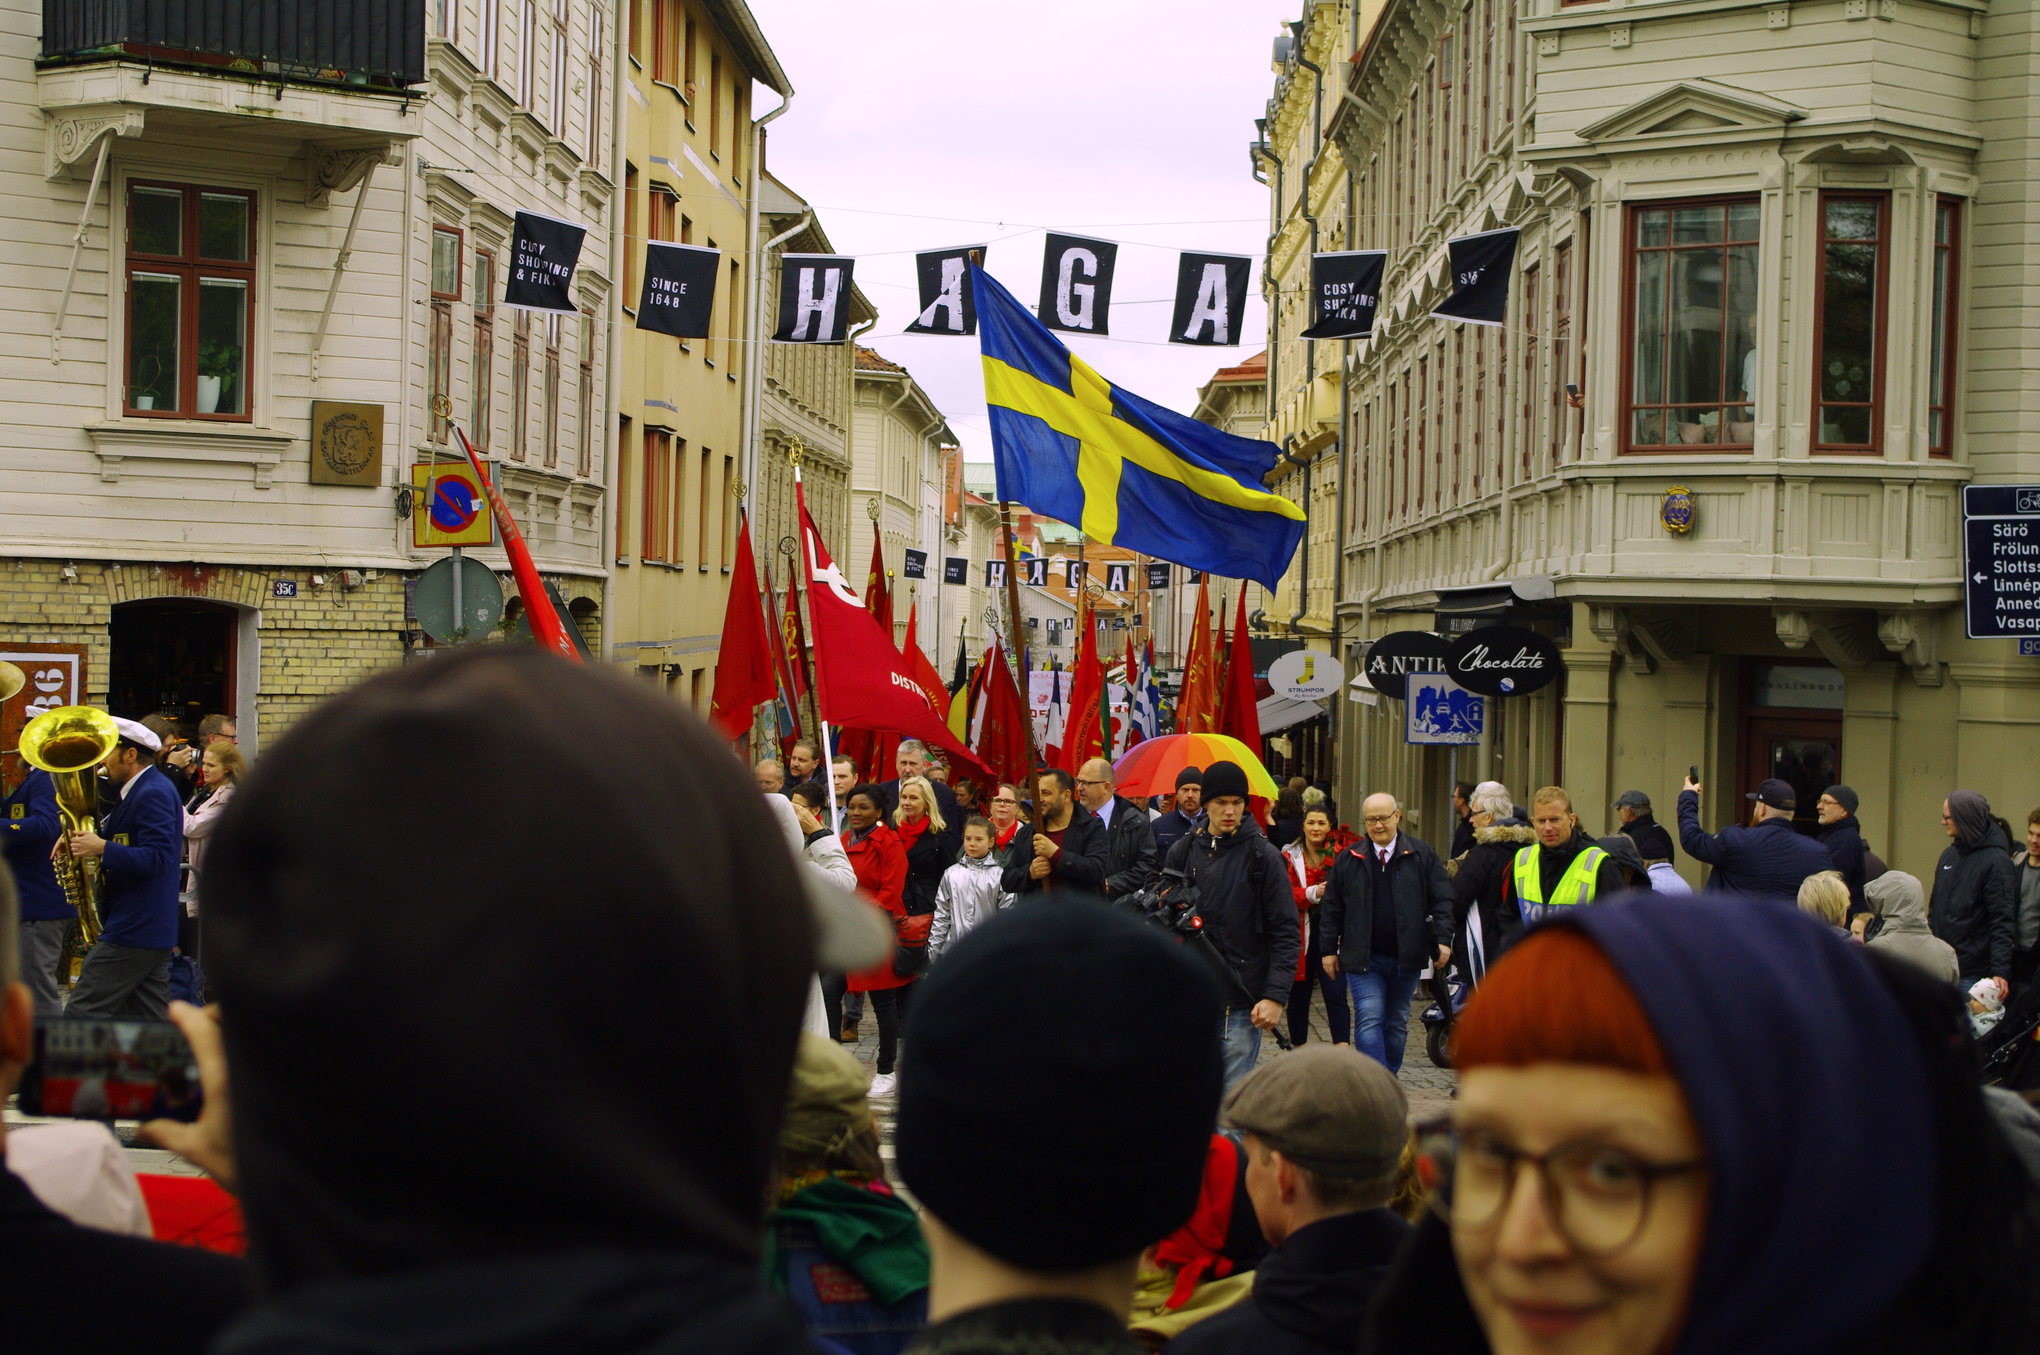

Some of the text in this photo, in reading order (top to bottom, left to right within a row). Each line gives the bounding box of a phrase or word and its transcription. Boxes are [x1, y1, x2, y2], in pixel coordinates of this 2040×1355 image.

[516, 268, 525, 281] &
[651, 277, 687, 295] SINCE
[1056, 247, 1098, 330] G
[1323, 282, 1355, 296] COSY
[650, 292, 680, 308] 1648
[1183, 263, 1228, 344] A
[1993, 523, 2028, 537] Särö
[1993, 542, 2039, 555] Frölun
[1458, 644, 1546, 672] Chocolate
